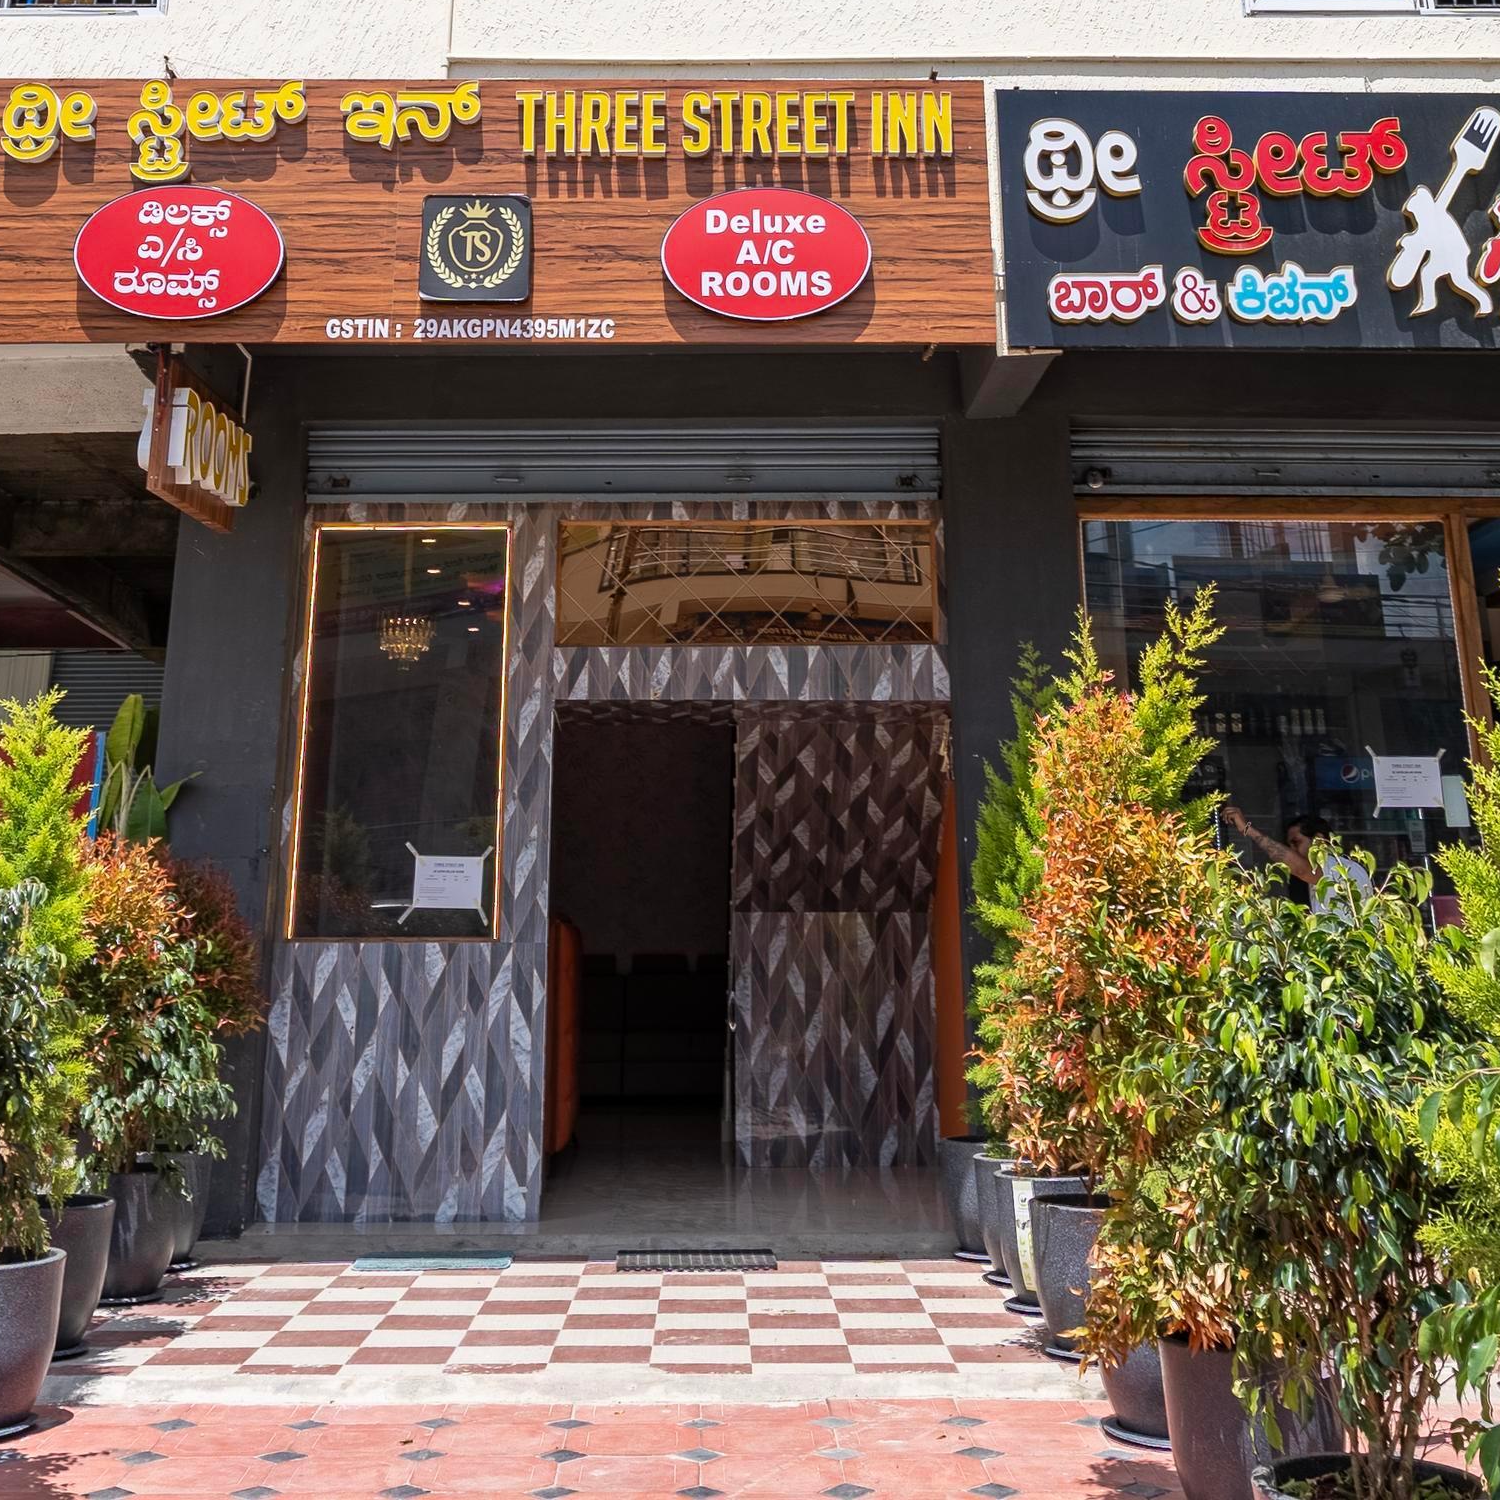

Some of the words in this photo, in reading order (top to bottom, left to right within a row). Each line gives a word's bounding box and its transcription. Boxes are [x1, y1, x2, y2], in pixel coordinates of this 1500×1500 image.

[339, 79, 482, 151] ಇನ್
[515, 89, 667, 157] THREE
[681, 89, 855, 157] STREET
[870, 90, 953, 158] INN
[705, 209, 826, 235] Deluxe
[460, 230, 492, 262] TS
[735, 239, 795, 266] A/C
[700, 271, 832, 297] ROOMS
[1054, 272, 1159, 314] ಬಾರ್
[1180, 273, 1216, 314] &
[325, 319, 389, 339] GSTIN
[413, 319, 615, 339] 29AKGPN4395M1ZC
